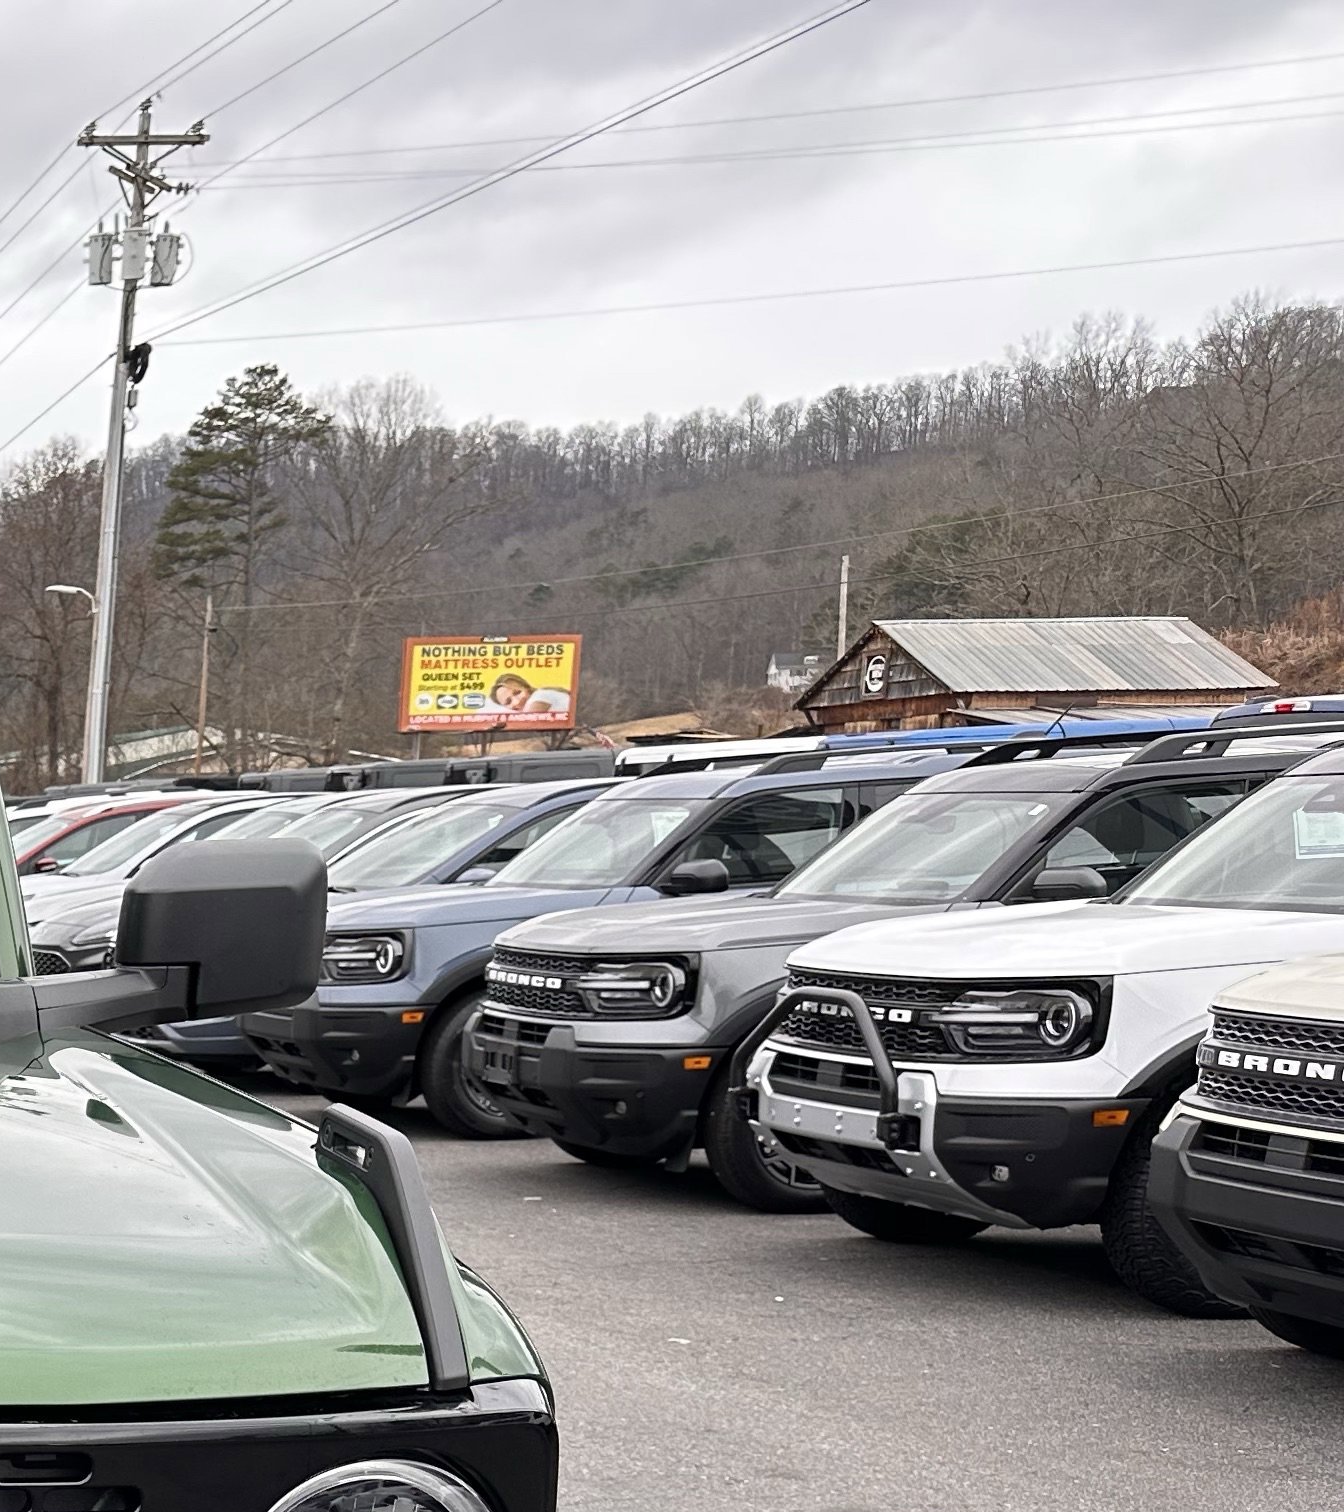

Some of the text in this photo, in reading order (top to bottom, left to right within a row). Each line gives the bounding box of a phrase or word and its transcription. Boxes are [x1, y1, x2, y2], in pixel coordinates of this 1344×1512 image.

[421, 644, 565, 658] NOTHING BUT BEDS
[420, 657, 564, 670] MATTRESS OUTLET
[422, 672, 482, 681] QUEEN SET
[459, 682, 485, 691] $499
[409, 715, 451, 724] LOCATED
[489, 969, 562, 989] BRONCO
[794, 1001, 912, 1023] RONCO
[1217, 1050, 1344, 1081] BRON
